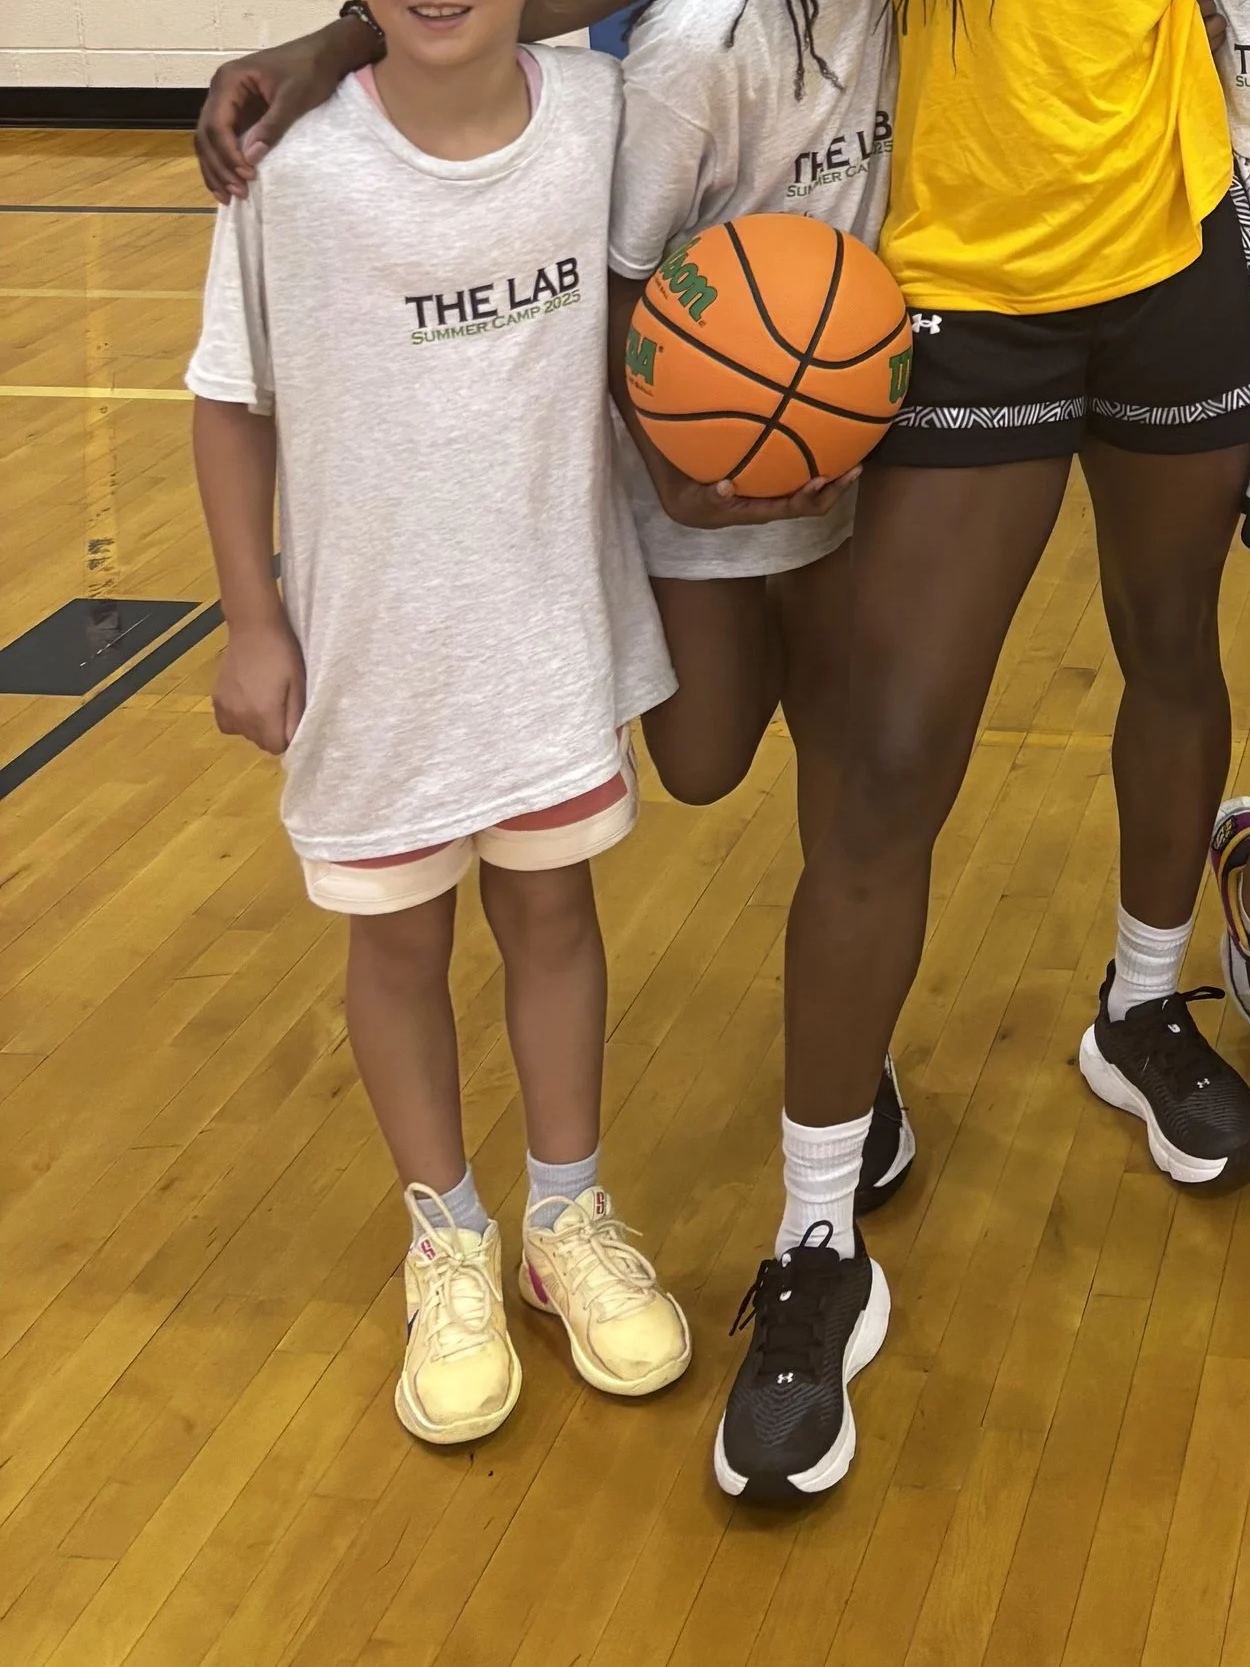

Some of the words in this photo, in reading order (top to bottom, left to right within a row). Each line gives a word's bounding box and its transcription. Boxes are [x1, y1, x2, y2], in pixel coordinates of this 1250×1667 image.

[855, 109, 894, 162] LB
[404, 282, 499, 329] THE
[506, 256, 581, 311] LAB
[411, 321, 489, 346] SUMMER
[491, 305, 542, 330] CAMP
[543, 288, 582, 315] 2025
